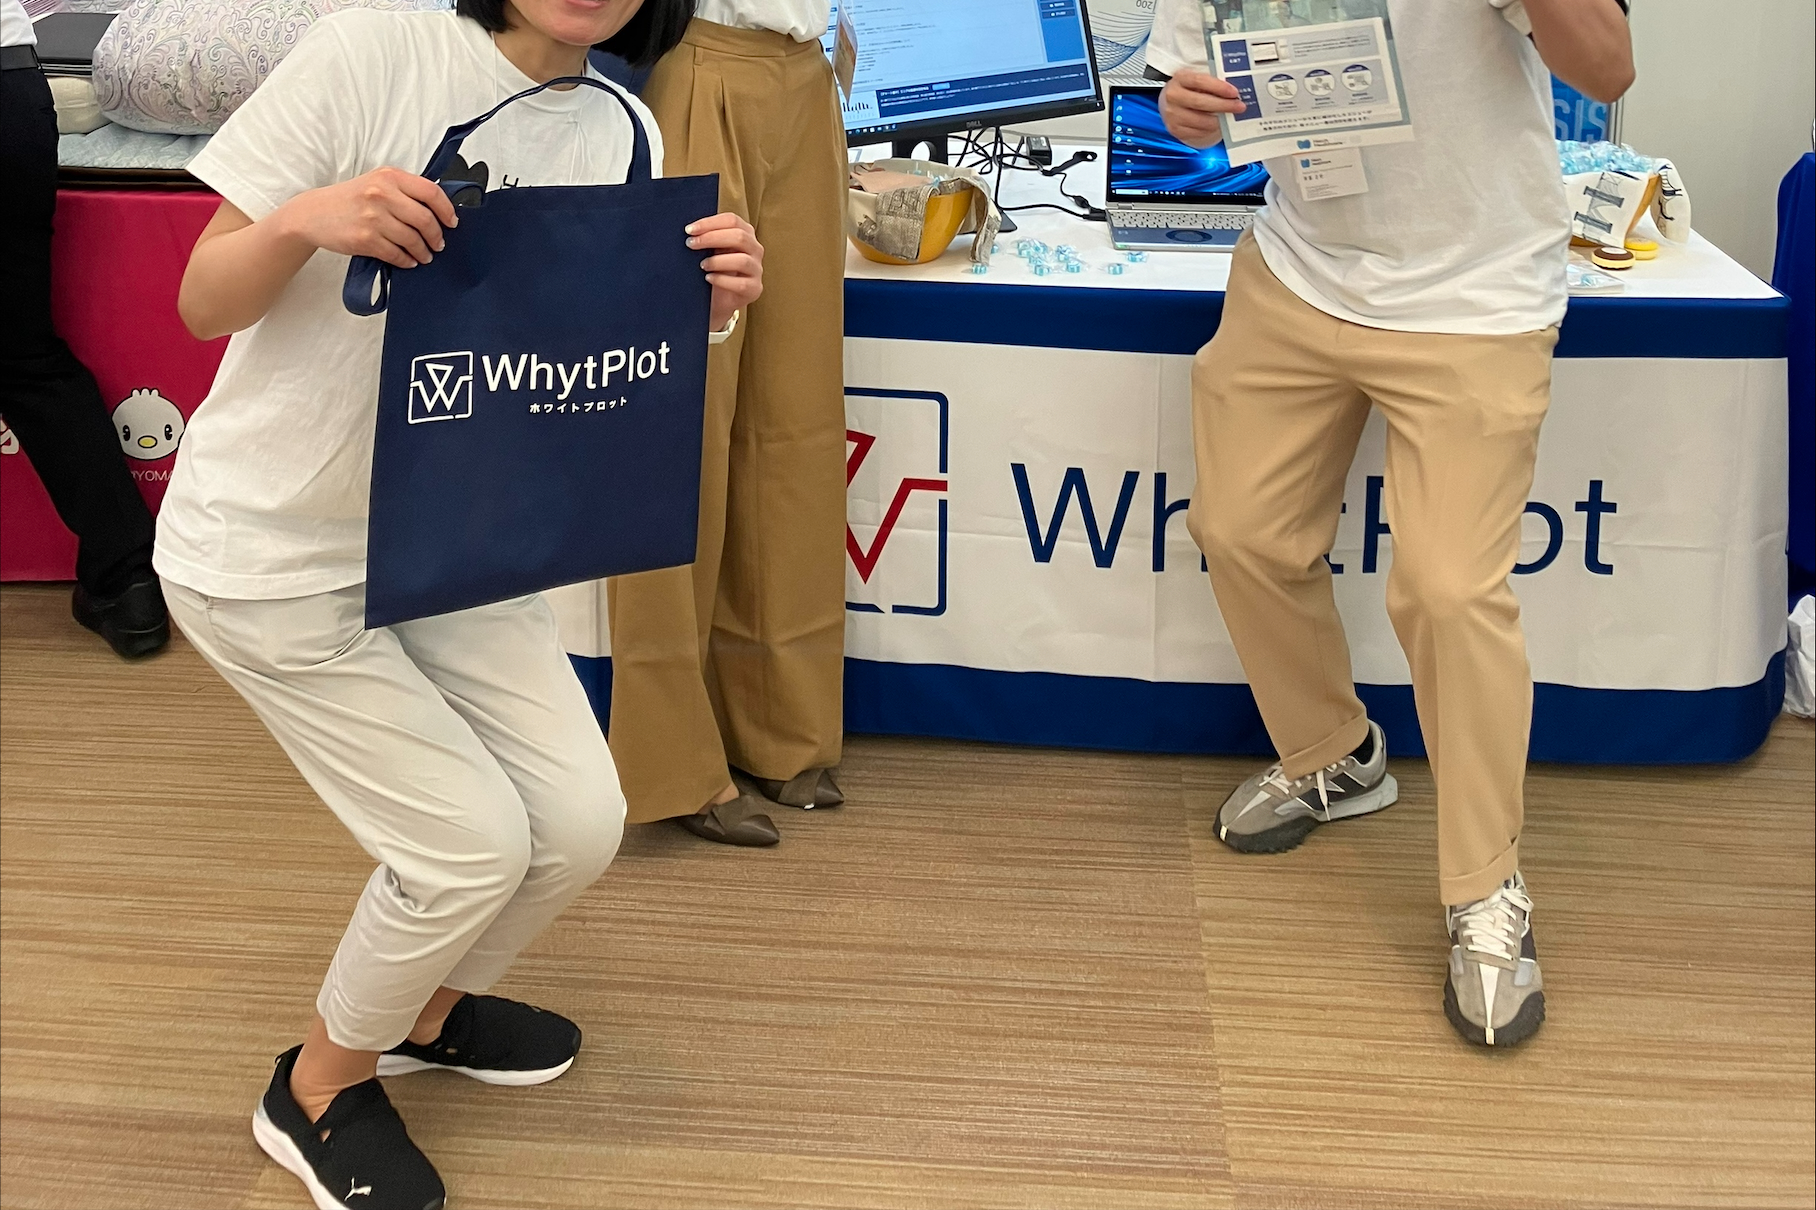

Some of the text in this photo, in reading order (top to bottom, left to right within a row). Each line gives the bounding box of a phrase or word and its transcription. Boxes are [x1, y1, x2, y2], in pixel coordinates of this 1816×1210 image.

[1135, 0, 1153, 9] 200
[482, 341, 671, 400] WhytPlot
[529, 395, 628, 415] ホワイトプロット
